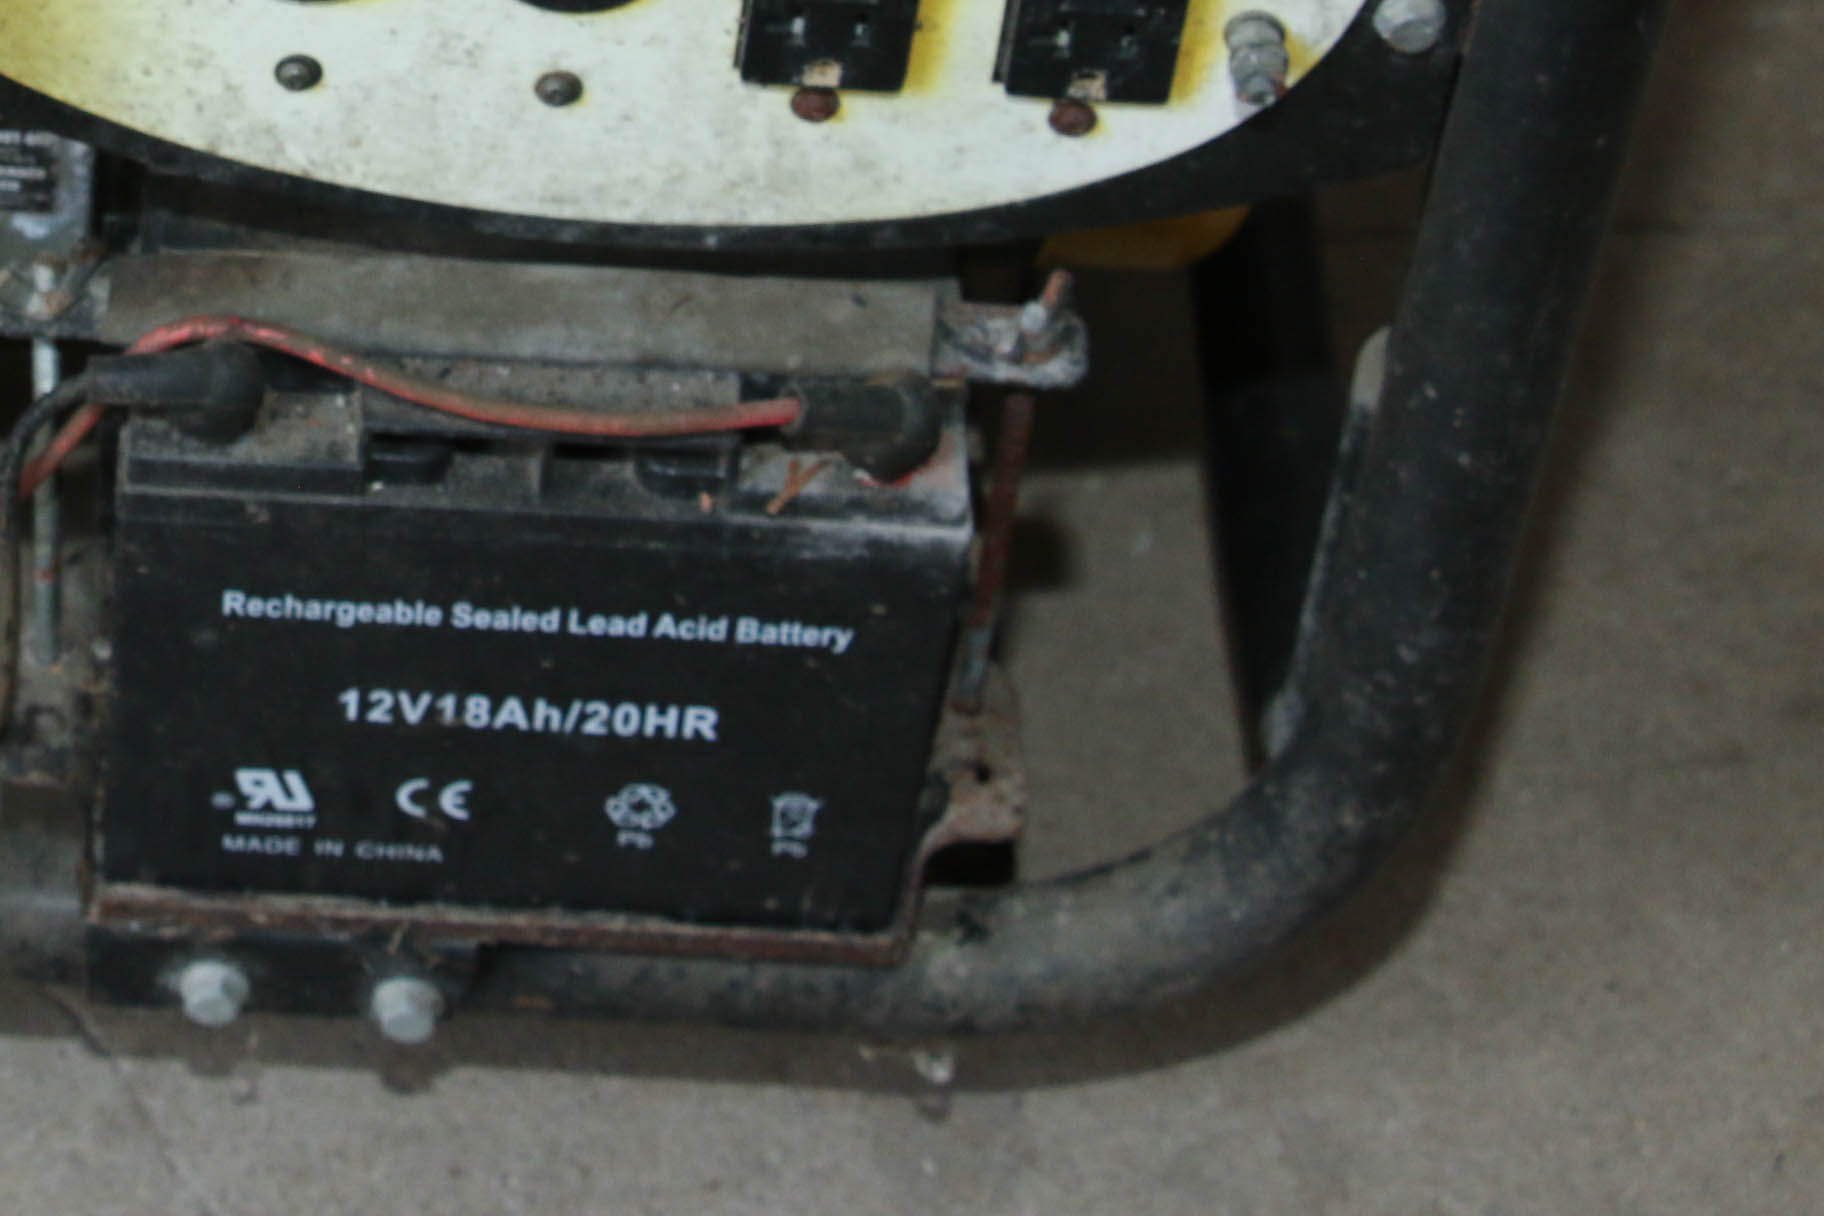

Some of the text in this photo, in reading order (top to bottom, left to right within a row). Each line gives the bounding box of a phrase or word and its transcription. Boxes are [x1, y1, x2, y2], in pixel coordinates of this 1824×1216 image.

[222, 589, 854, 653] Rechargeable Sealed Lead Acid Battery
[338, 687, 719, 741] 12V18Ah/20HR
[222, 835, 443, 862] MADE IN CHINA
